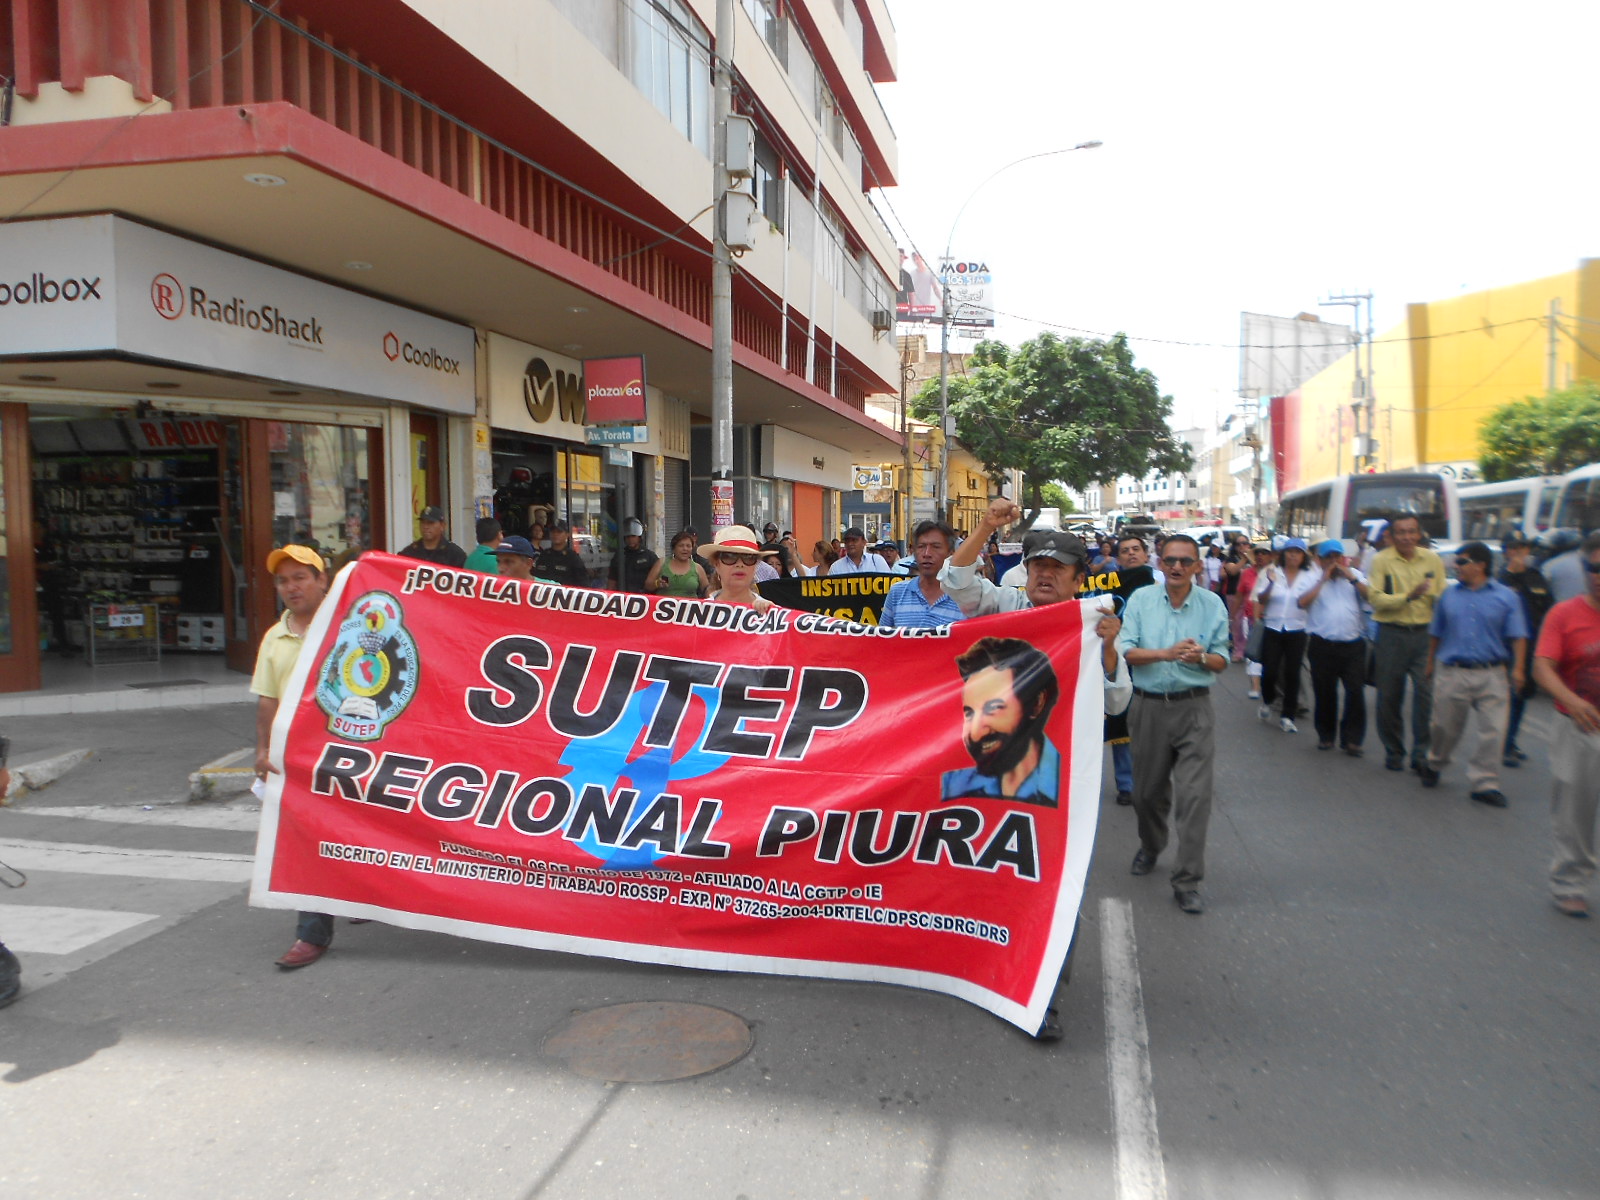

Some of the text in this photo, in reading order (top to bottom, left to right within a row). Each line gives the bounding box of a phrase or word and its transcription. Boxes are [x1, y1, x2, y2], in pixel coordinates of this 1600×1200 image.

[940, 262, 990, 274] MODA
[189, 286, 324, 345] RadioShack
[402, 341, 460, 376] Coolbox
[588, 379, 642, 401] plazavea
[603, 430, 631, 440] Torata
[403, 566, 476, 598] ¡POR
[481, 576, 522, 605] LA
[527, 582, 649, 621] UNIDAD
[656, 599, 790, 635] SINDICAL
[465, 634, 869, 761] SUTEP
[333, 717, 377, 737] SUTEP
[310, 742, 1040, 883] REGIONAL PIURA
[319, 841, 387, 867] INSCRITO
[388, 852, 413, 872] EN
[413, 856, 435, 874] EL
[435, 858, 523, 886] MINISTERIO
[521, 871, 545, 888] DE
[548, 874, 617, 899] TRABAJO
[619, 880, 670, 902] ROSSP
[679, 888, 712, 909] EXP.
[619, 870, 644, 879] DE
[645, 870, 683, 882] 1972
[693, 871, 765, 892] AFILIADO
[766, 879, 780, 897] A
[780, 880, 800, 899] LA
[803, 884, 849, 900] CGTP
[863, 883, 883, 900] IE
